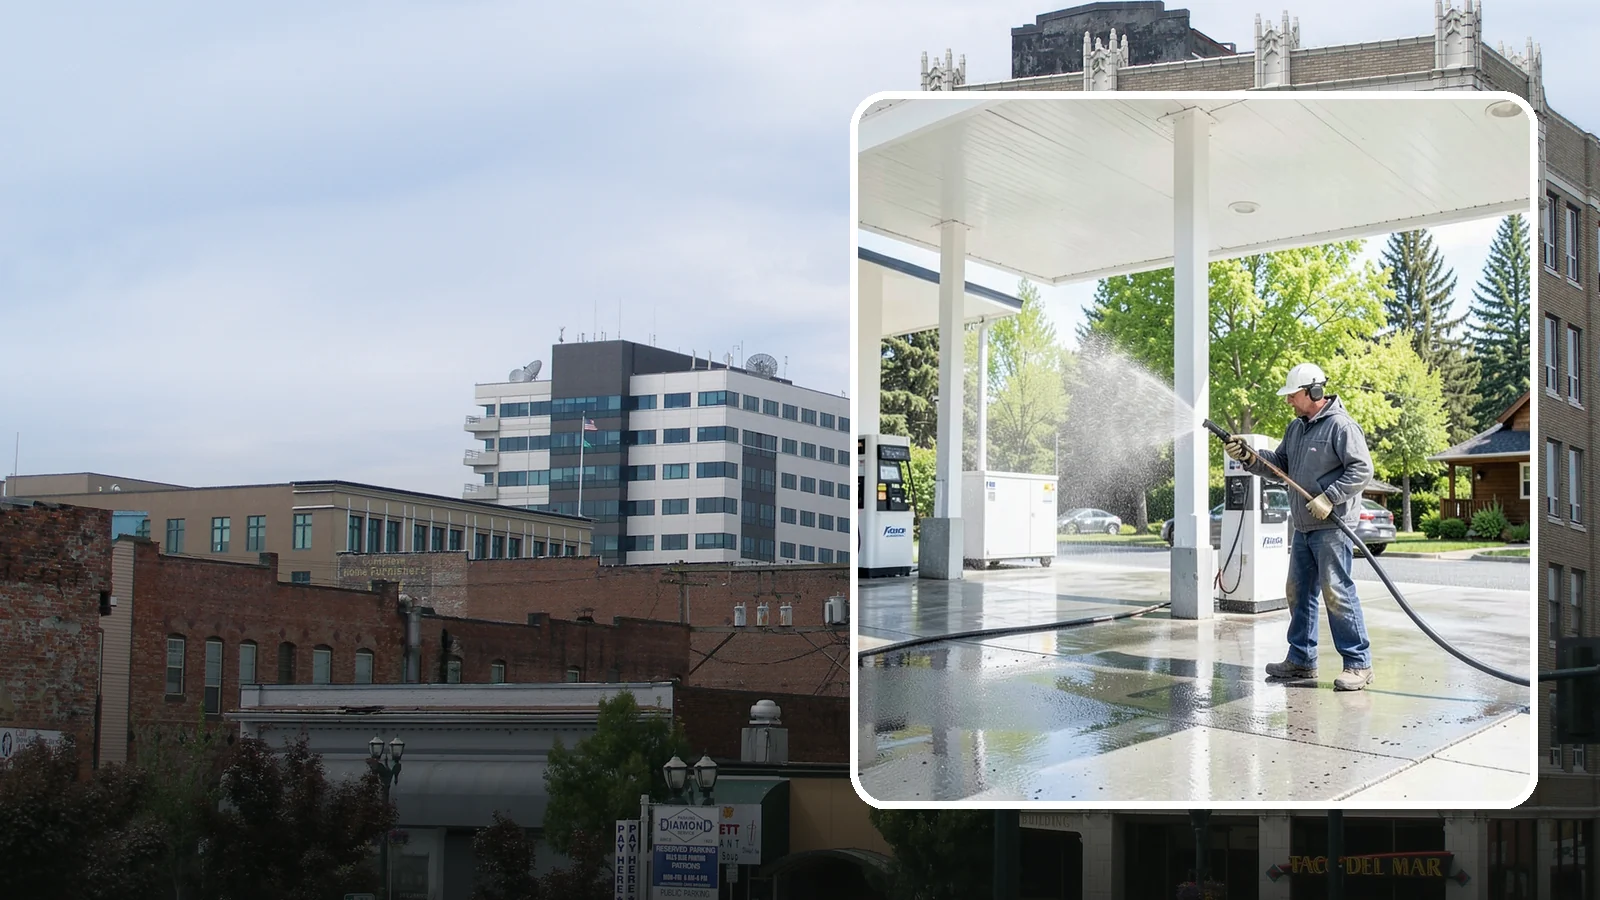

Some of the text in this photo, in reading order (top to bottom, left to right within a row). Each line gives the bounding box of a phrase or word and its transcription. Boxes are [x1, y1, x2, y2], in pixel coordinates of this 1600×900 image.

[660, 818, 713, 833] DIAMOND
[1021, 815, 1072, 828] BUILDING
[628, 825, 637, 893] PAY HERE
[722, 851, 739, 863] Soup
[671, 862, 701, 870] PATRONS
[1289, 855, 1443, 877] TAC DEL MAR
[617, 856, 625, 893] HERE
[660, 888, 710, 899] PUBLIC PARKING
